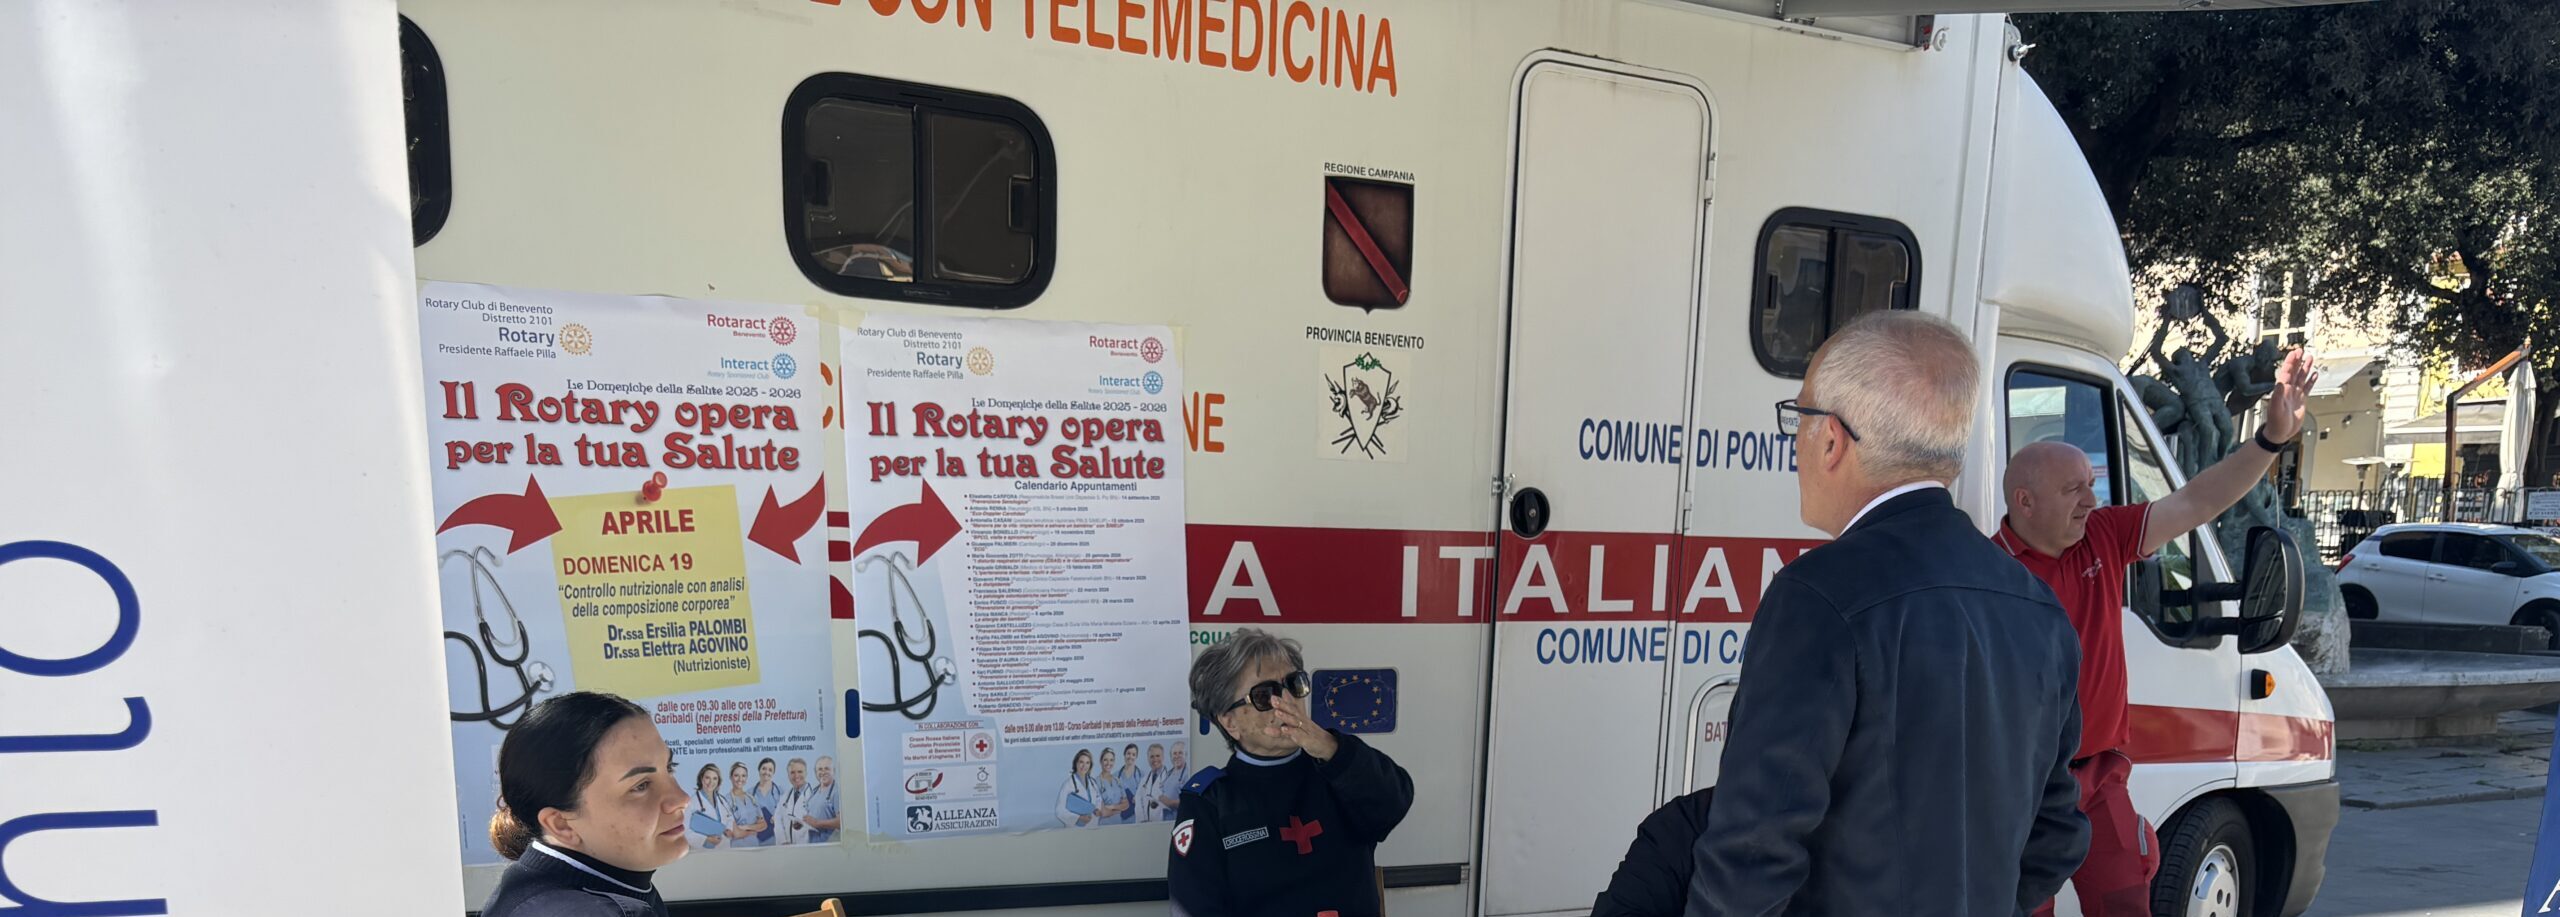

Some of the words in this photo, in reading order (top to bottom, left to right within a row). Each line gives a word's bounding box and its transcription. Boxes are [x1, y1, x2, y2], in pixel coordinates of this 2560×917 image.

[1324, 162, 1366, 176] REGIONE
[1368, 167, 1415, 182] CAMPANIA
[425, 298, 458, 311] Rotary
[461, 300, 485, 311] Club
[488, 301, 497, 311] di
[500, 302, 553, 314] Benevento
[482, 313, 526, 324] Distretto
[529, 316, 552, 325] 2101
[707, 314, 766, 330] Rotaract
[499, 327, 555, 347] Rotary
[857, 328, 885, 338] Rotary
[887, 328, 906, 338] Club
[908, 329, 917, 338] di
[918, 330, 963, 339] Benevento
[1306, 326, 1362, 345] PROVINCIA
[1364, 331, 1424, 350] BENEVENTO
[904, 340, 940, 349] Distretto
[942, 341, 962, 349] 2101
[1089, 336, 1139, 350] Rotaract
[439, 344, 492, 356] Presidente
[494, 347, 534, 358] Raffaele
[536, 348, 556, 359] Pilla
[720, 357, 769, 370] Interact
[917, 352, 963, 369] Rotary
[867, 368, 911, 379] Presidente
[913, 369, 945, 379] Raffaele
[947, 371, 964, 380] Pilla
[1099, 375, 1140, 387] Interact
[567, 379, 584, 391] Le
[587, 380, 653, 395] Domeniche
[656, 383, 683, 394] della
[686, 384, 723, 396] Salute
[725, 386, 759, 398] 2025
[769, 388, 801, 399] 2026
[439, 380, 479, 420] Il
[495, 383, 659, 433] Rotary
[675, 401, 799, 435] opera
[971, 397, 985, 408] Le
[988, 398, 1043, 412] Domeniche
[1045, 400, 1068, 409] della
[1070, 401, 1100, 411] Salute
[1103, 402, 1131, 412] 2025
[1140, 403, 1167, 412] 2026
[867, 401, 898, 436] Il
[912, 402, 1049, 446] Rotary
[1061, 415, 1165, 447] opera
[445, 439, 514, 470] per
[524, 433, 562, 466] la
[574, 433, 649, 468] tua
[662, 431, 800, 472] Salute
[1578, 418, 1682, 464] COMUNE
[1696, 429, 1718, 469] DI
[870, 455, 926, 482] per
[936, 448, 966, 477] la
[978, 446, 1039, 478] tua
[1050, 444, 1165, 480] Salute
[1014, 481, 1068, 491] Calendario
[1070, 481, 1138, 491] Appuntamenti
[602, 509, 695, 535] APRILE
[563, 554, 665, 575] DOMENICA
[670, 553, 693, 571] 19
[620, 579, 684, 597] nutrizionale
[687, 581, 706, 593] con
[710, 577, 745, 593] analisi
[572, 601, 599, 618] della
[602, 600, 678, 618] composizione
[608, 624, 643, 641] Dr.ssa
[645, 621, 686, 639] Ersilia
[689, 618, 747, 635] PALOMBI
[603, 642, 640, 659] Dr.ssa
[642, 641, 685, 657] Elettra
[689, 636, 749, 654] AGOVINO
[1536, 627, 1667, 665] COMUNE
[1682, 630, 1709, 665] DI
[673, 656, 751, 675] (Nutrizioniste)
[657, 701, 678, 712] dalle
[681, 703, 694, 711] ore
[696, 700, 719, 711] 09.30
[721, 700, 736, 711] alle
[738, 702, 752, 710] ore
[754, 699, 776, 710] 13.00
[654, 712, 693, 724] Garibaldi
[696, 712, 712, 723] (nei
[713, 712, 740, 724] pressi
[742, 711, 762, 721] della
[764, 709, 807, 722] Prefettura)
[697, 723, 741, 734] Benevento
[684, 738, 714, 746] specialisti
[716, 737, 743, 745] volontari
[696, 747, 707, 755] loro
[934, 807, 997, 821] ALLEANZA
[934, 818, 998, 831] ASSICURAZIONI
